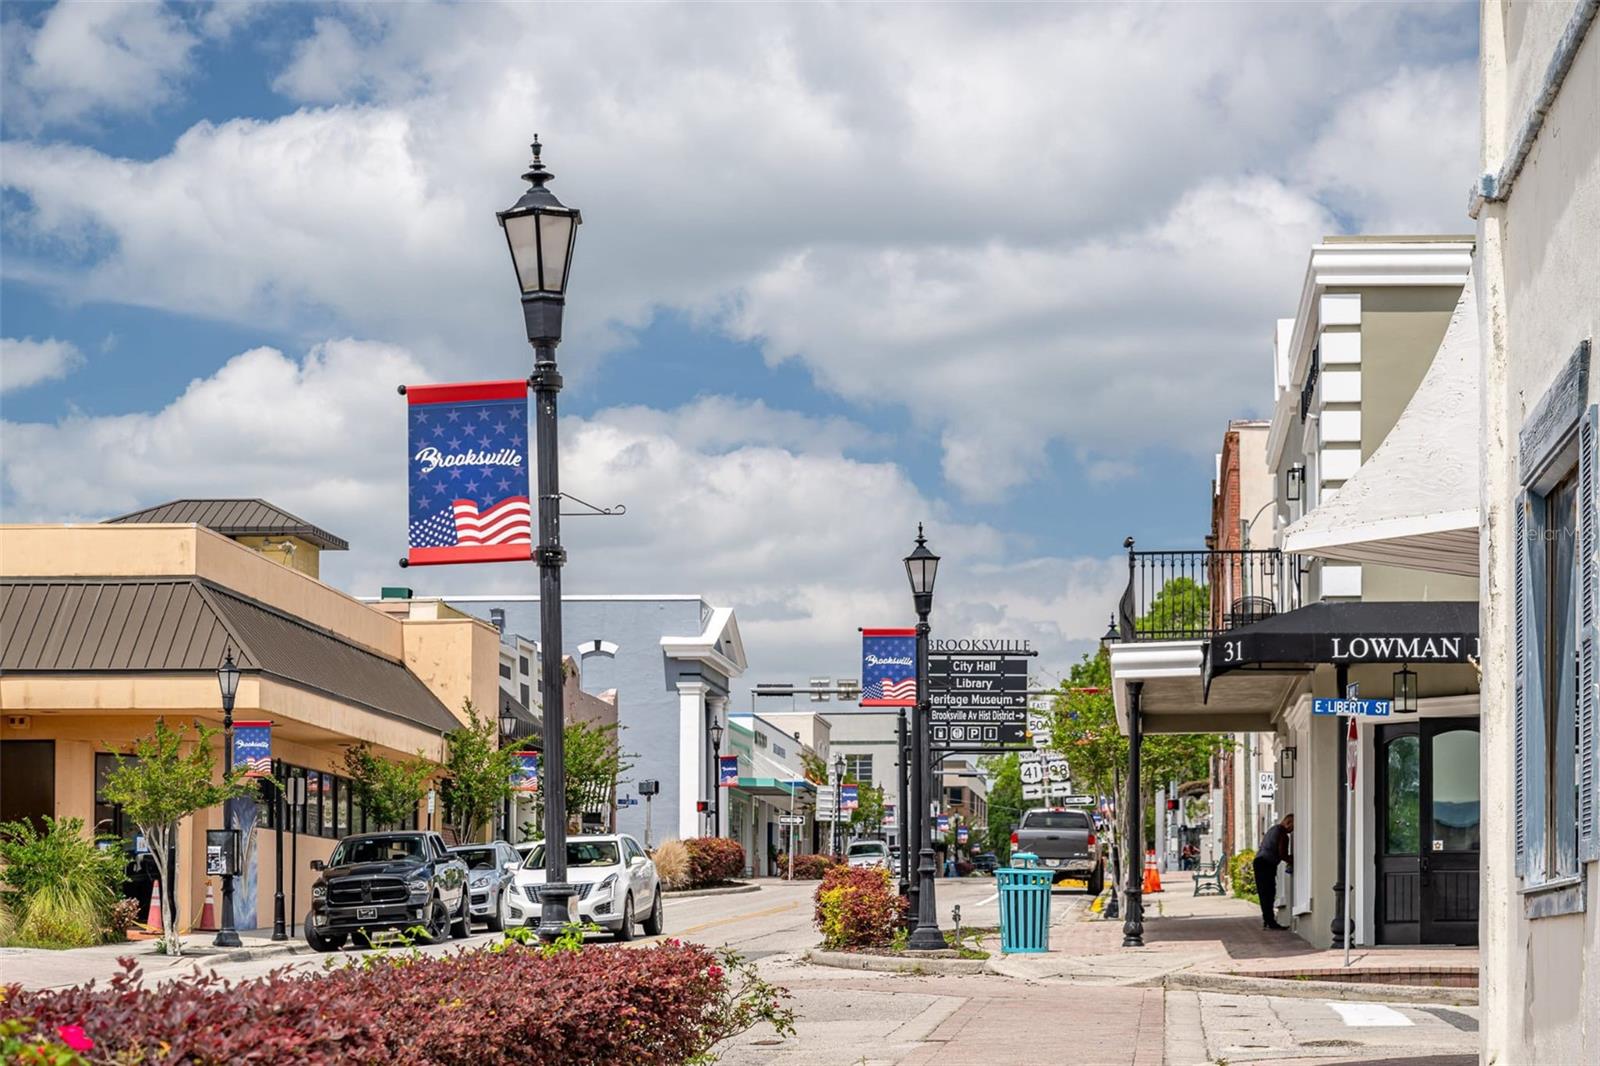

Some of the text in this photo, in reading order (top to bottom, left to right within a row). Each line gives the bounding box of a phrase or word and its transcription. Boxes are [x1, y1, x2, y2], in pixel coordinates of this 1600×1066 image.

[415, 446, 522, 473] Brooksville
[928, 639, 1030, 652] BROOKSVILLE
[1224, 640, 1243, 662] 31
[1331, 637, 1461, 658] LOWMAN
[865, 654, 913, 667] Brooksville
[953, 661, 996, 672] City Hall
[956, 678, 993, 690] Library
[971, 694, 1013, 704] Museum
[1315, 700, 1388, 713] E LIBERTY ST
[931, 710, 1015, 720] Brooksville Av Hist District
[1023, 766, 1038, 779] 41
[1049, 764, 1067, 779] 98
[1260, 774, 1273, 782] ON
[1260, 783, 1273, 791] WA
